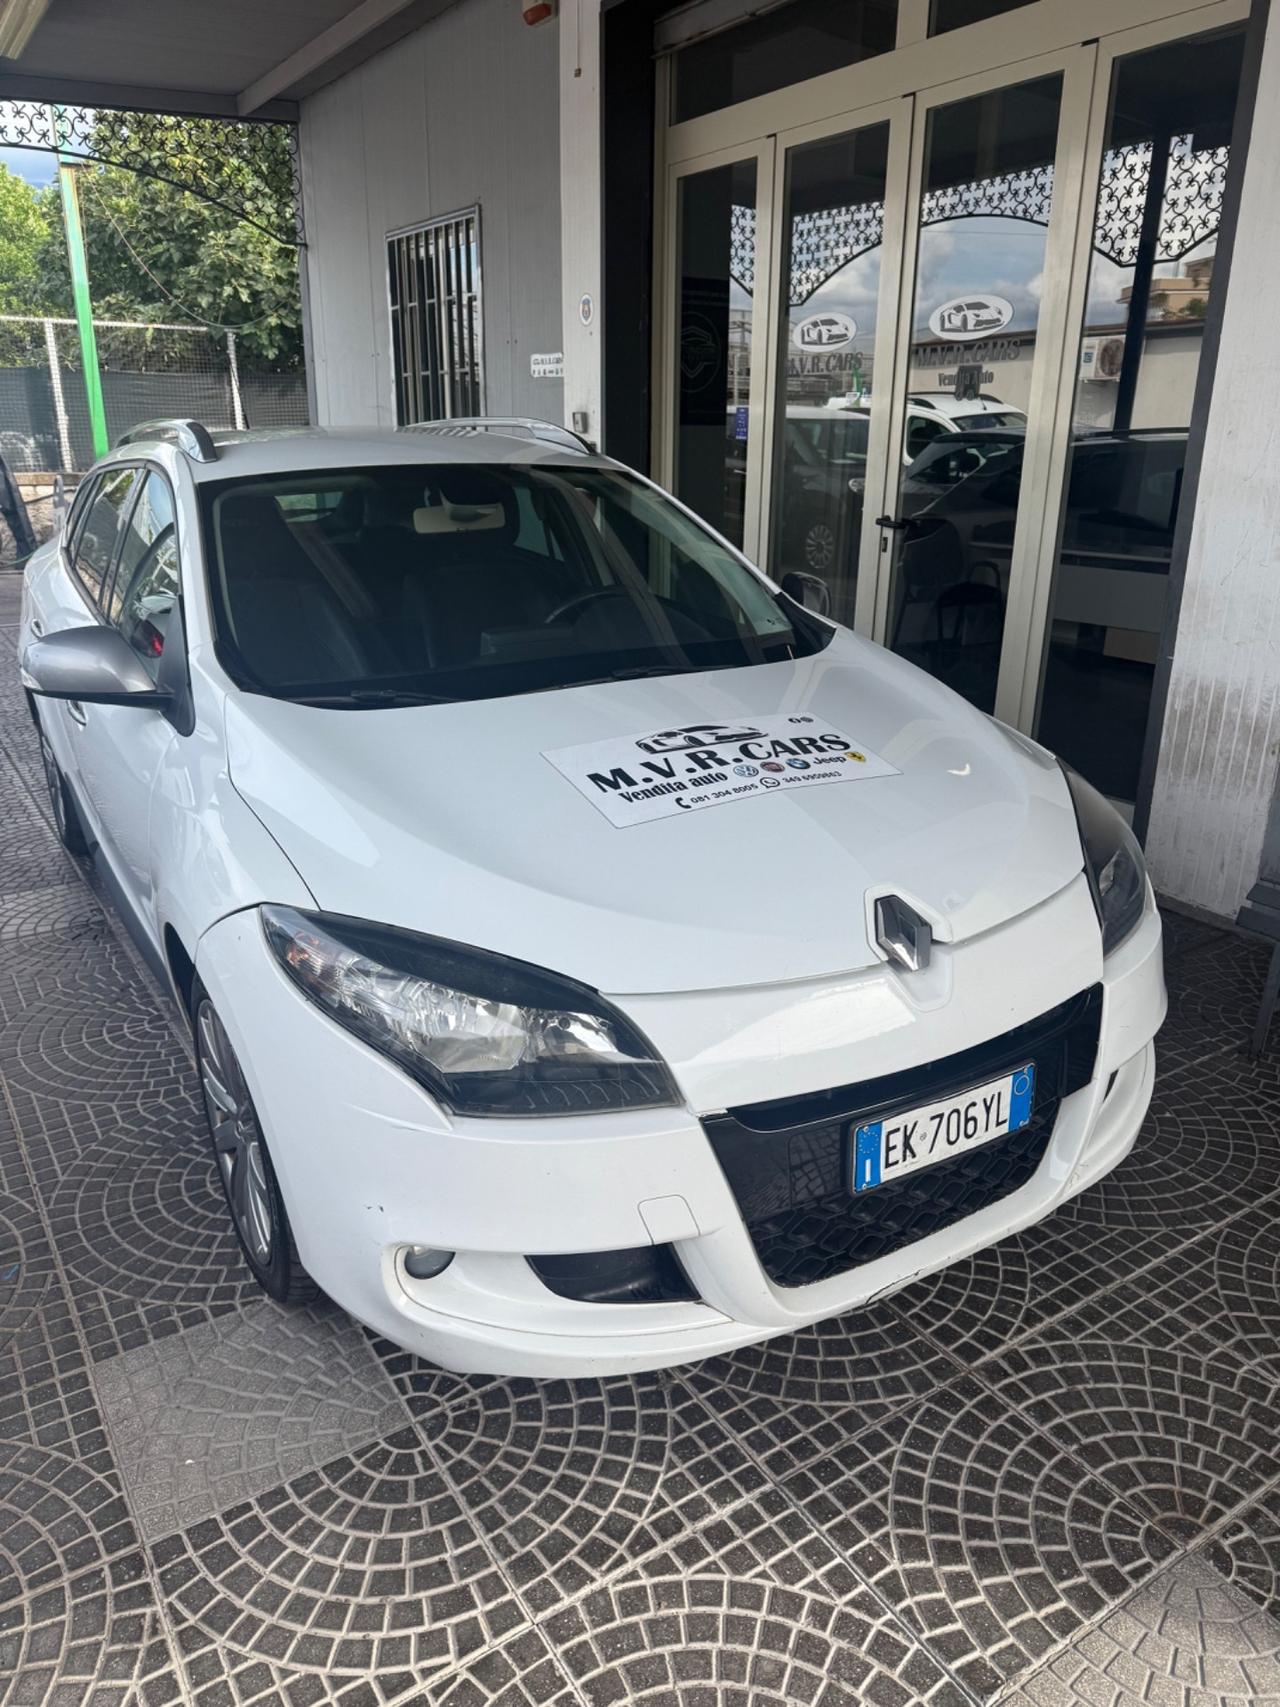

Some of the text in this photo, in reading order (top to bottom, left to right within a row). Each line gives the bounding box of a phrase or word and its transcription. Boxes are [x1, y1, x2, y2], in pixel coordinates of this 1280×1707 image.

[813, 756, 847, 765] Jeep
[617, 771, 728, 803] Vendita auto
[690, 783, 759, 804] 081 304 8005
[884, 1091, 1008, 1169] EK 706YL
